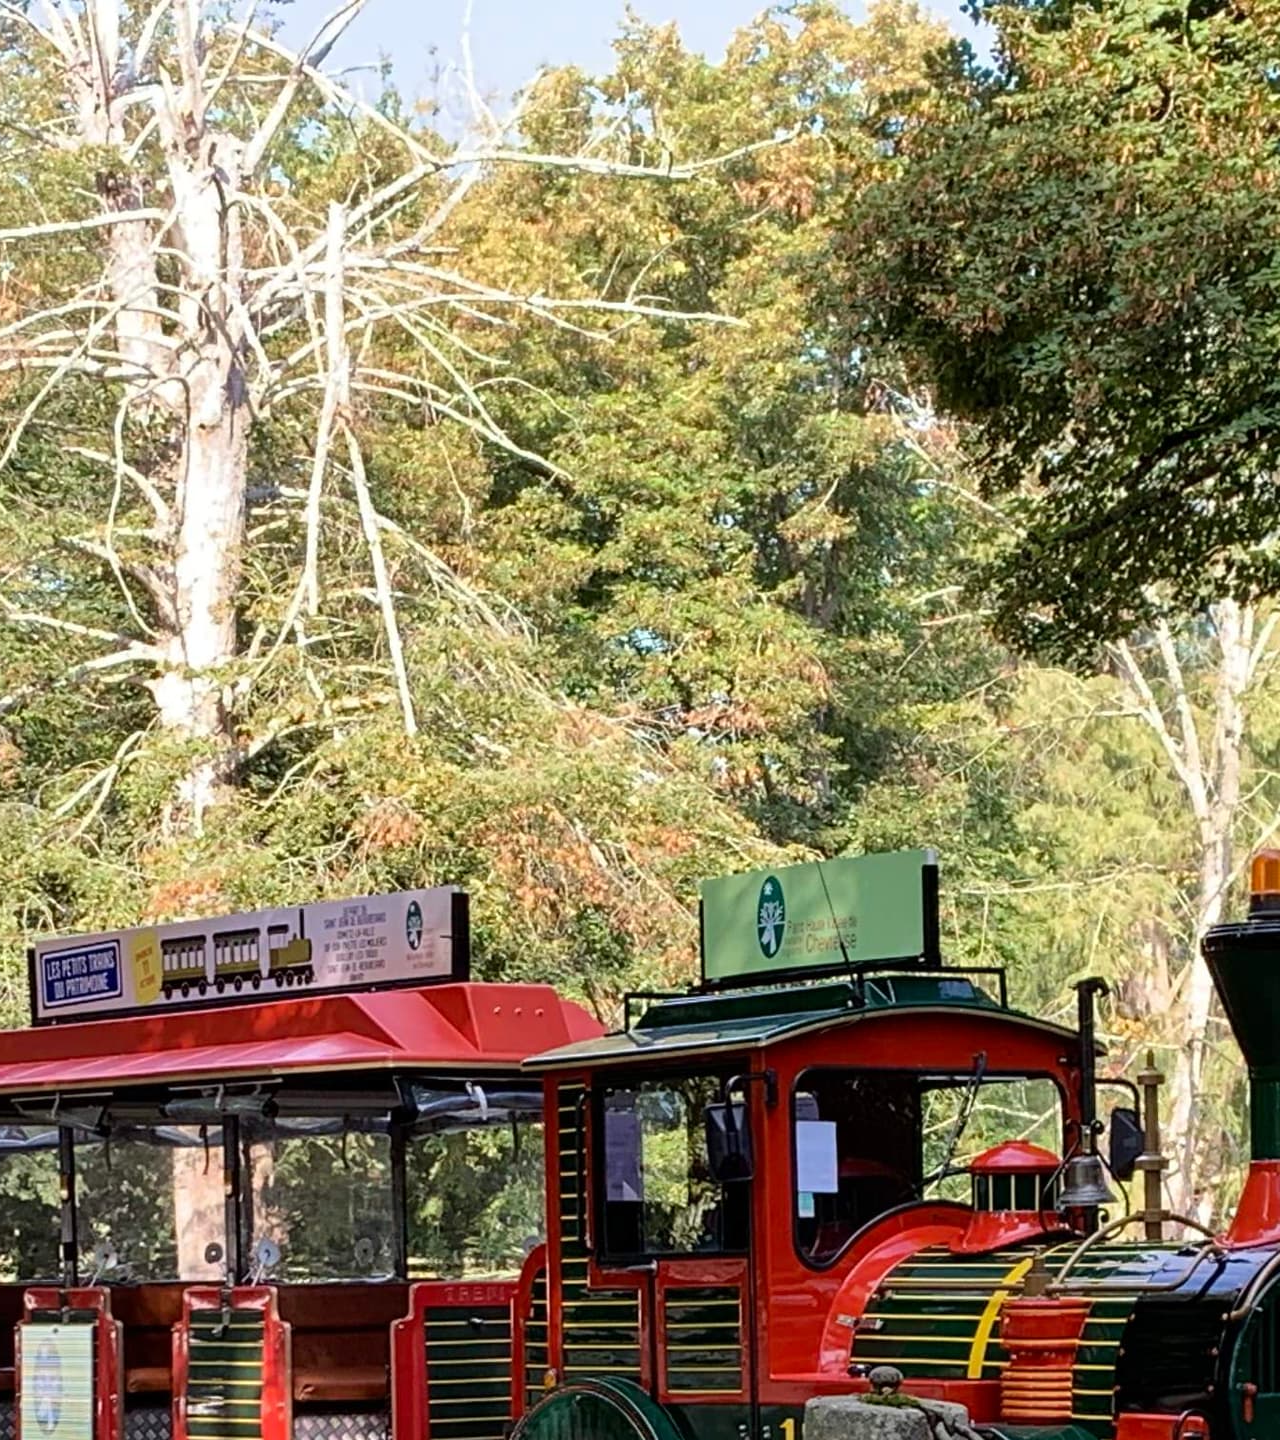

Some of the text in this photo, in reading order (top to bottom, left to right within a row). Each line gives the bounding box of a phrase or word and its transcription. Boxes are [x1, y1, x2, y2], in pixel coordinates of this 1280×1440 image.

[46, 961, 61, 981] LES
[61, 956, 88, 978] PETITS
[87, 950, 115, 972] TRAINS
[53, 972, 110, 999] DU PATRIMOINE
